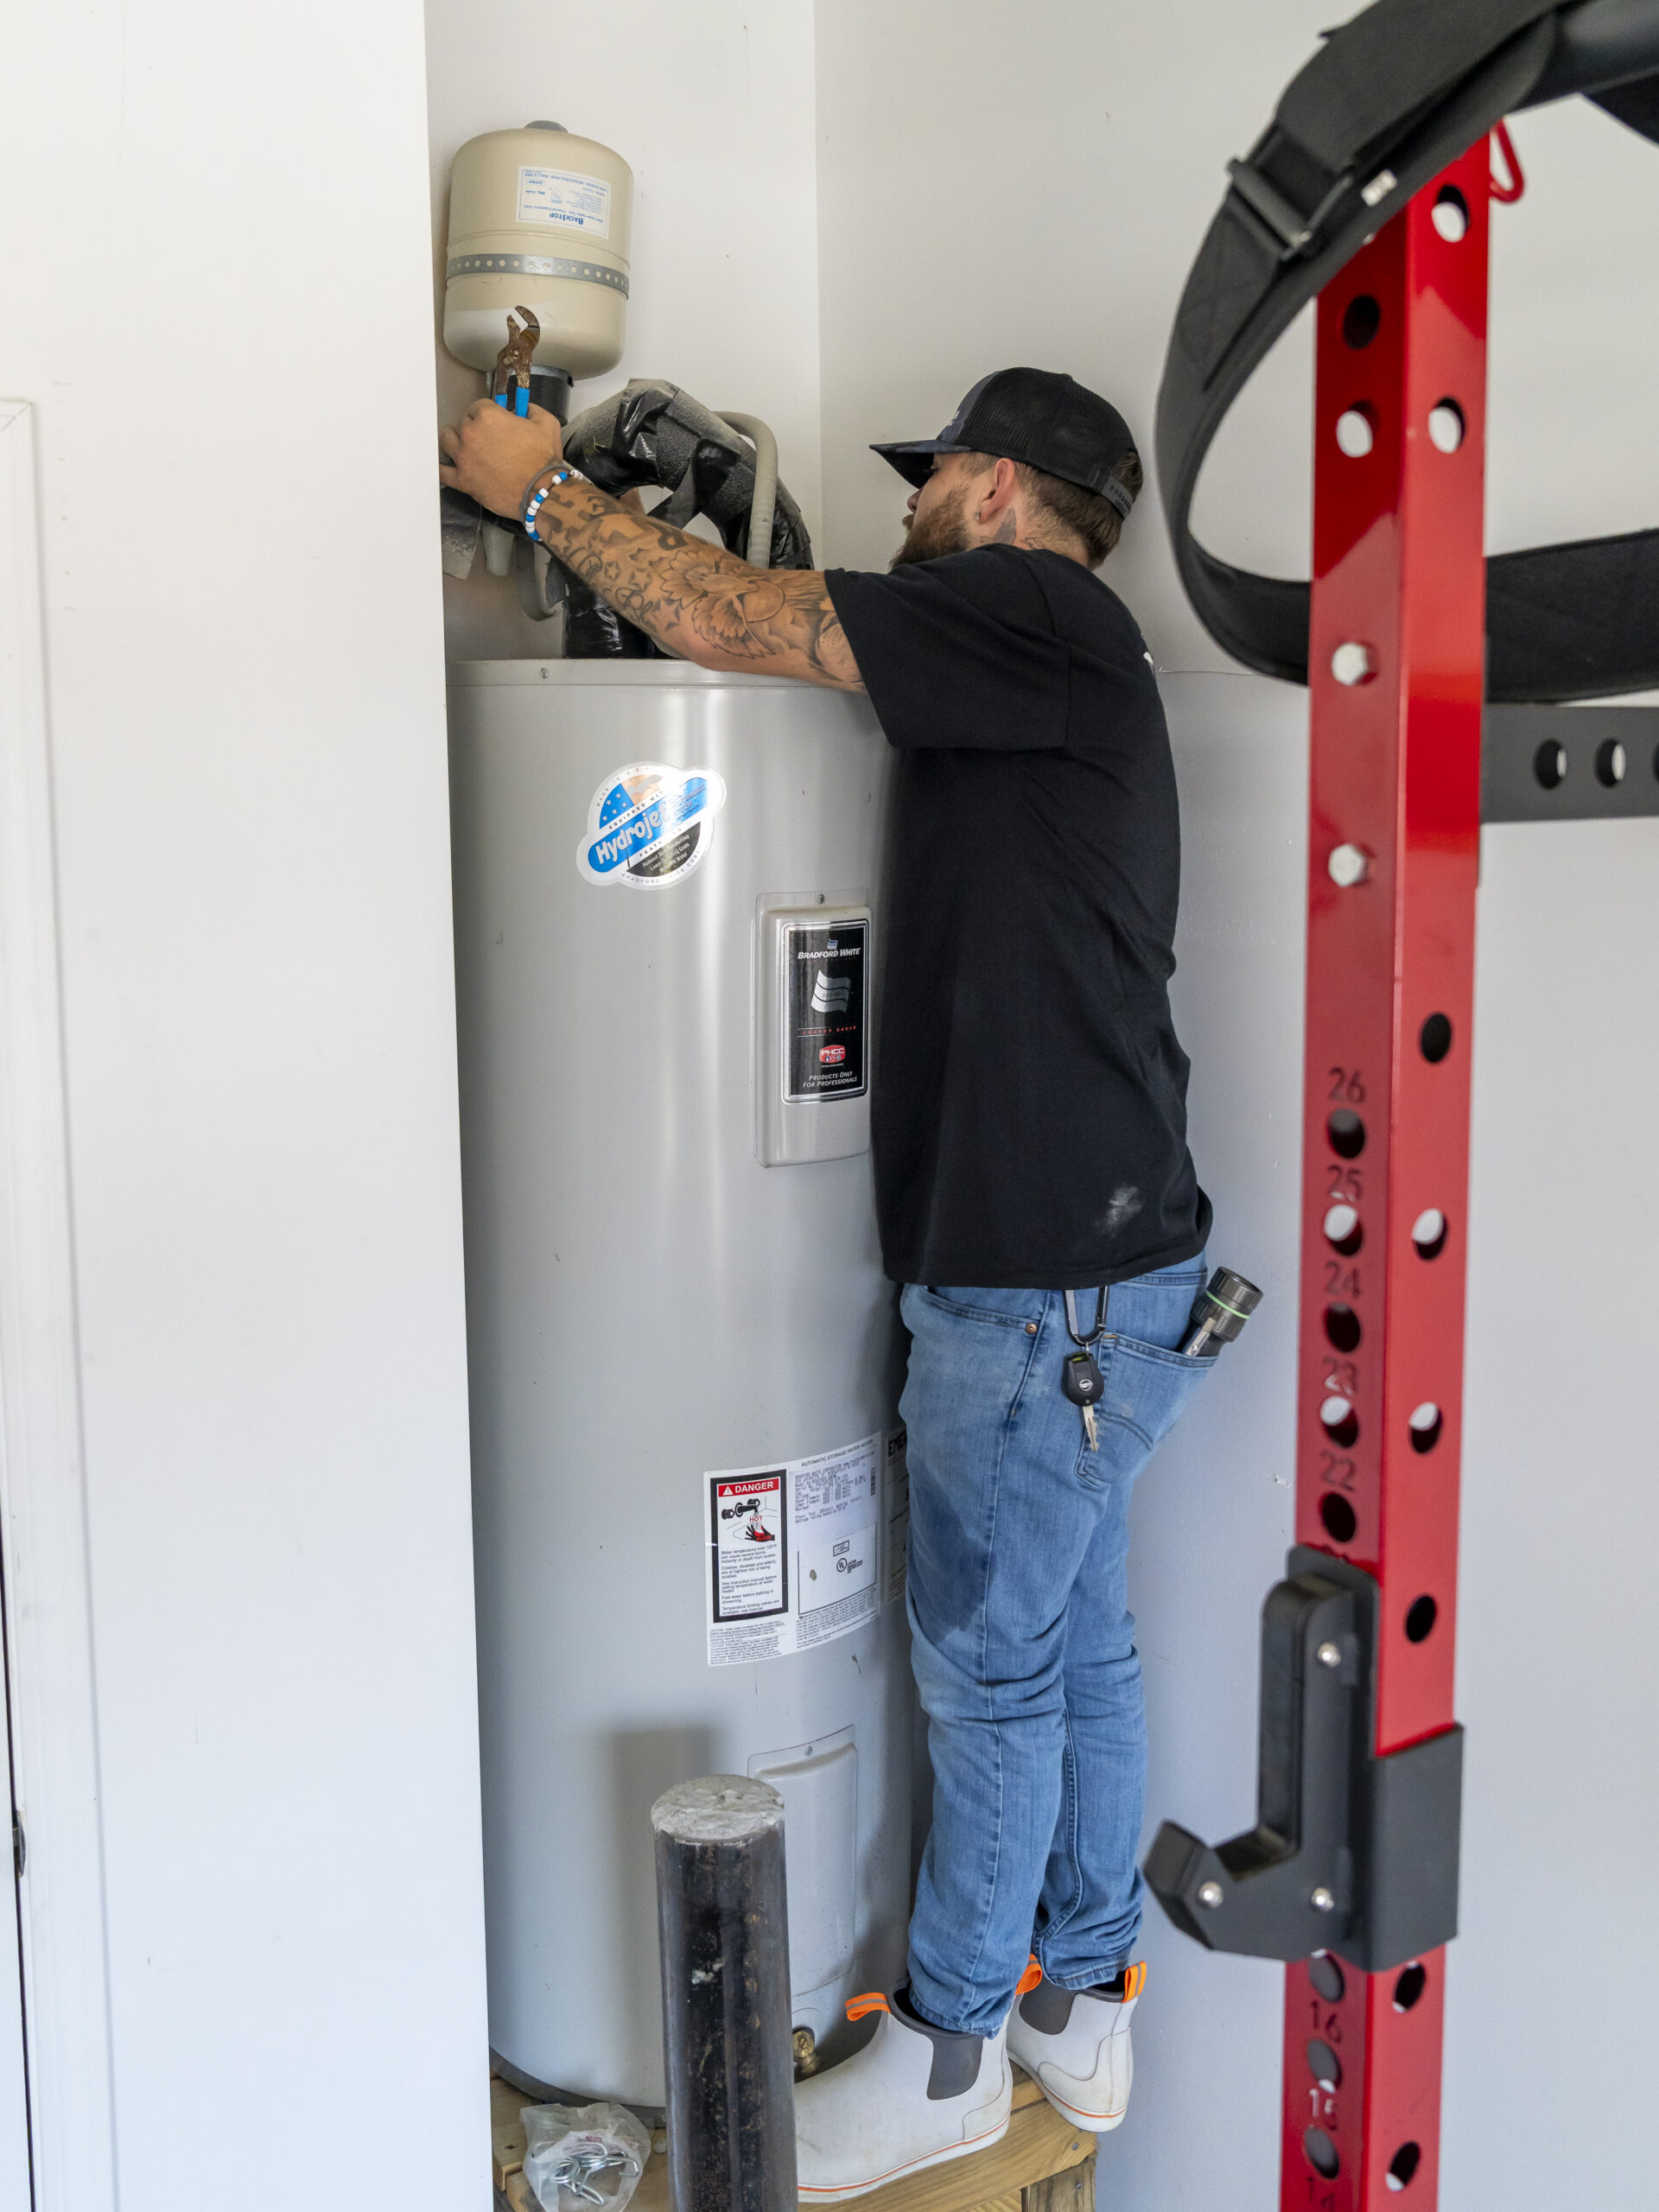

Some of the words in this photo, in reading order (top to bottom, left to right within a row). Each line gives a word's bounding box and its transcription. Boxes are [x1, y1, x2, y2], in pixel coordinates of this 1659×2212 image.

[595, 803, 671, 865] Hydrojet
[608, 803, 645, 830] EQUIPPED
[798, 950, 838, 959] BRADFORD
[840, 948, 861, 957] WHITE
[817, 1077, 857, 1086] PROFESSIONALS
[1329, 1066, 1367, 1104] 26
[1327, 1165, 1363, 1202] 25
[1325, 1260, 1360, 1299] 24
[801, 1457, 827, 1466] AUTOMATIC
[827, 1451, 847, 1460] STORAGE
[1320, 1450, 1357, 1493] 22
[734, 1481, 773, 1493] DANGER
[1310, 1999, 1341, 2043] 16
